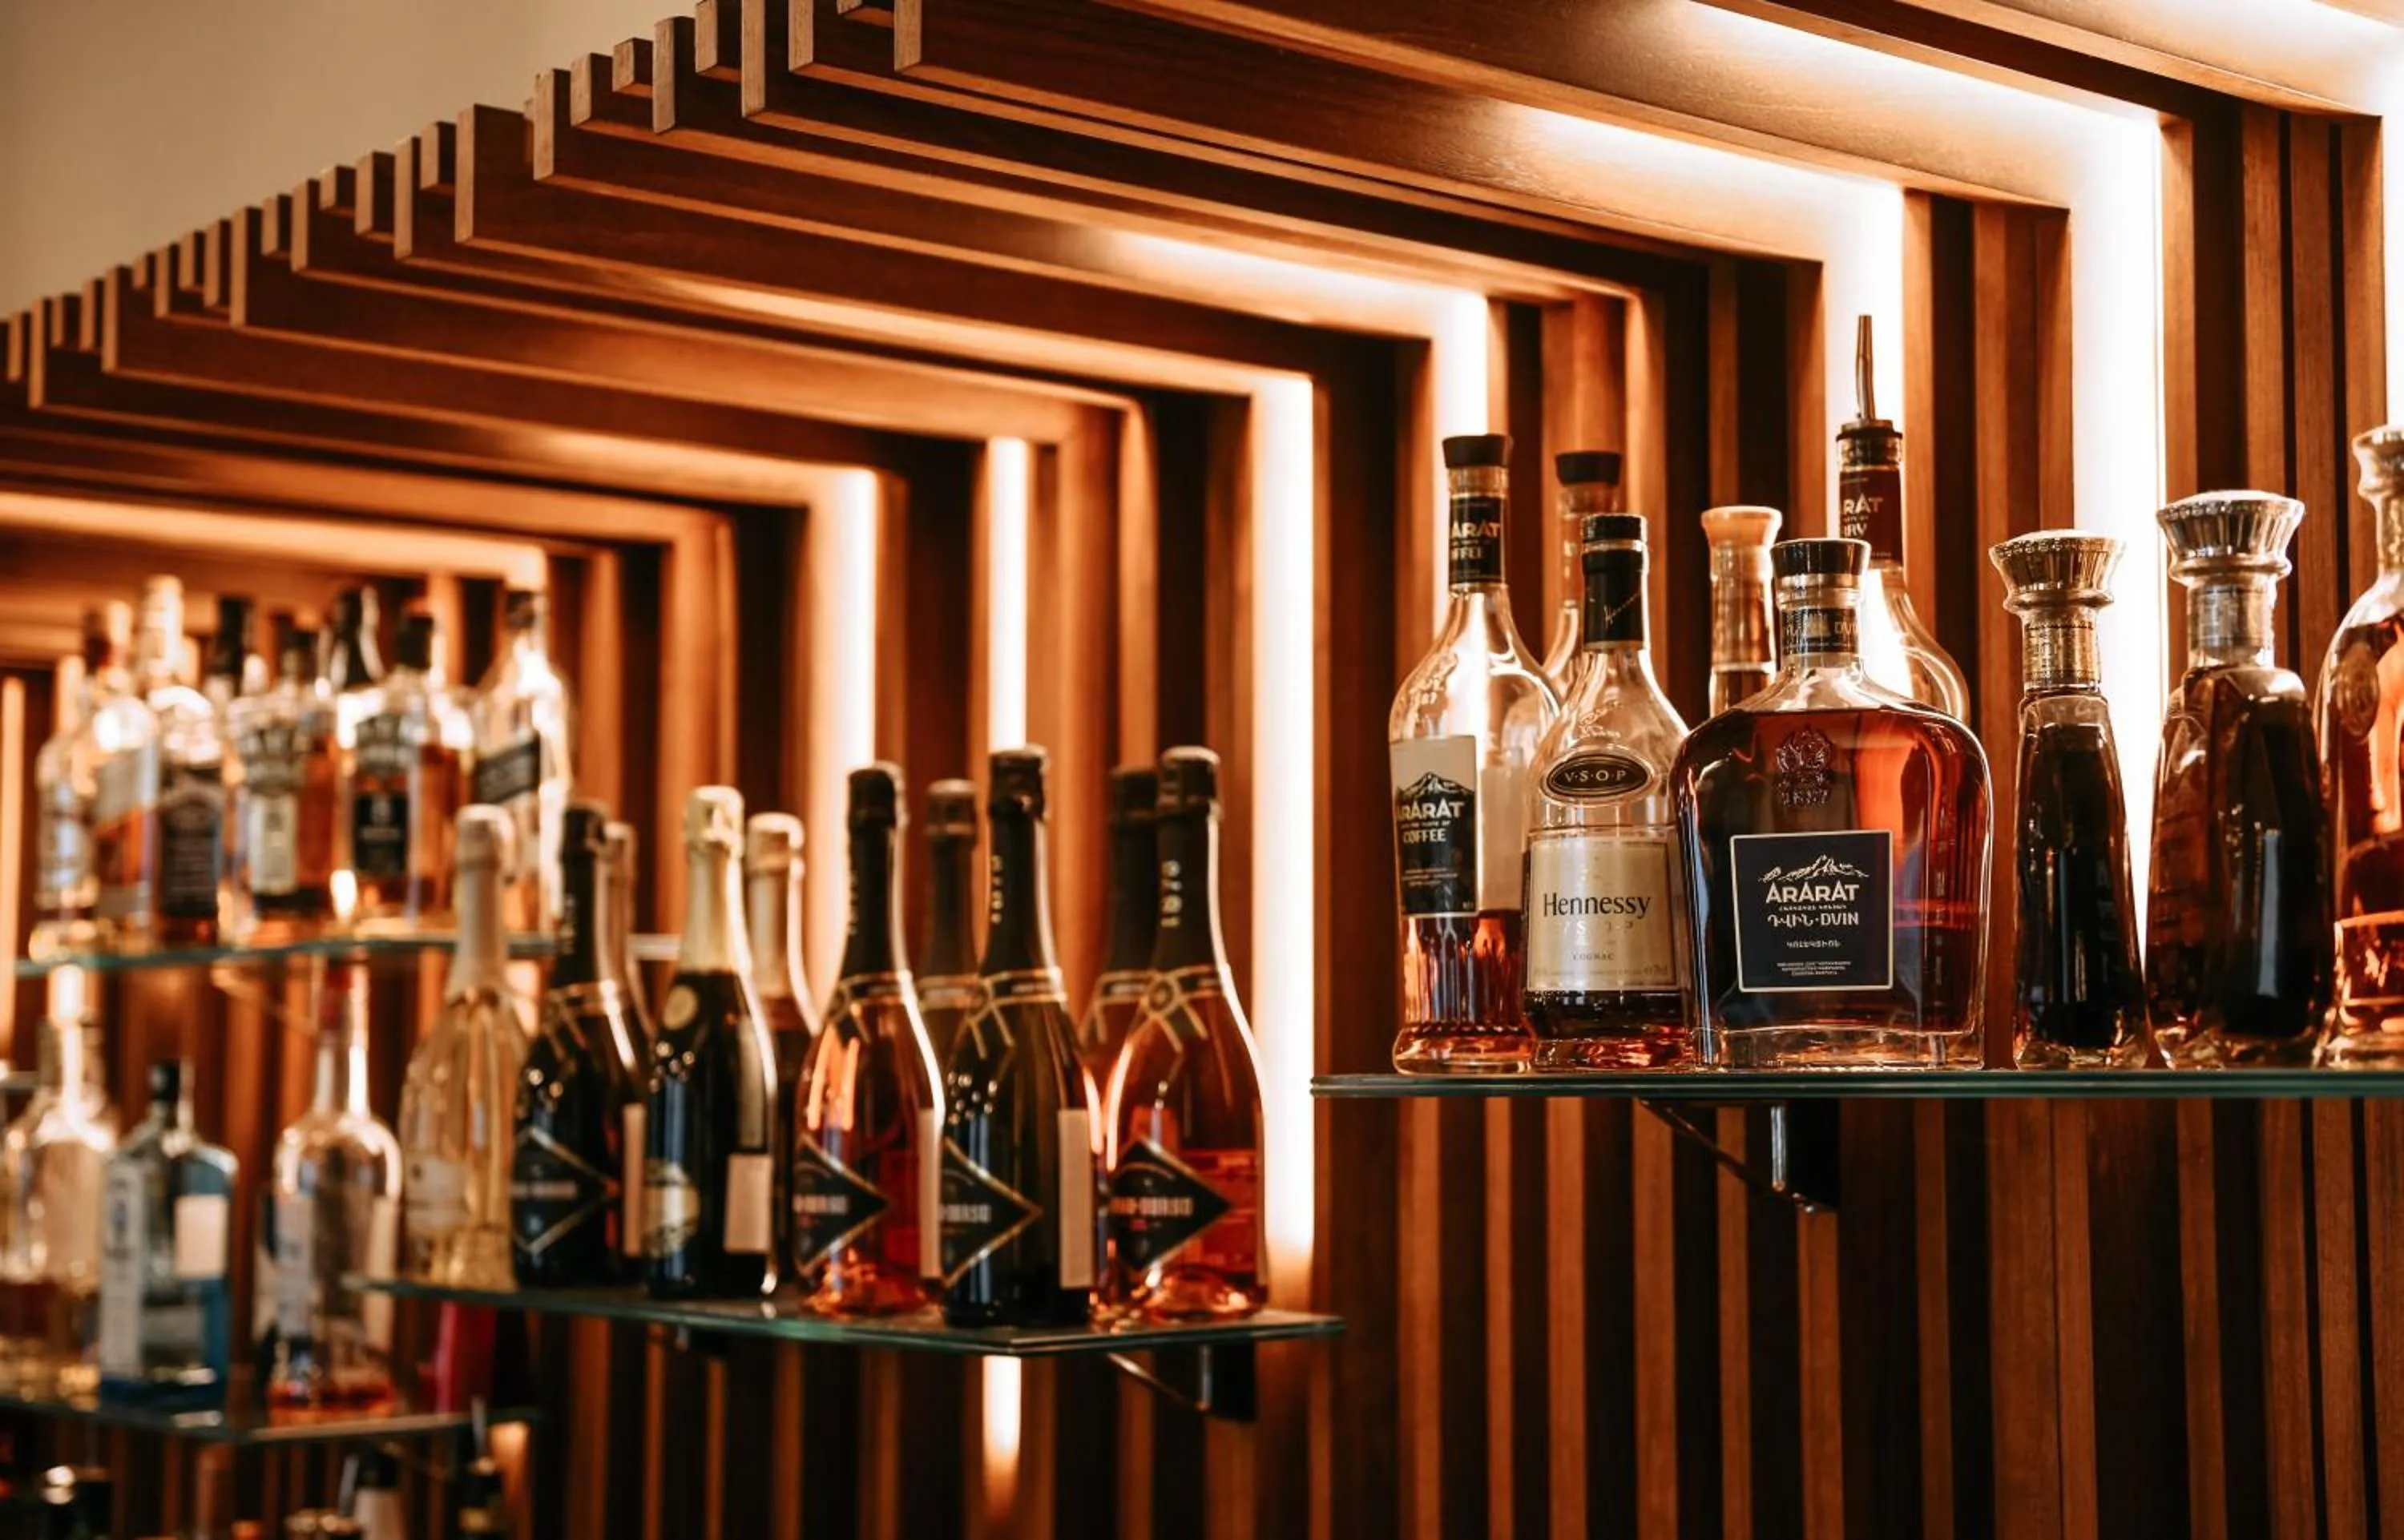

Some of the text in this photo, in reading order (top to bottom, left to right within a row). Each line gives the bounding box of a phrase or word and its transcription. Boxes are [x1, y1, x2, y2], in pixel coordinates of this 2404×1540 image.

[1843, 494, 1883, 514] RAT
[1451, 519, 1500, 538] ARAT
[1765, 880, 1860, 904] ARARAT
[1543, 892, 1652, 920] Hennessy
